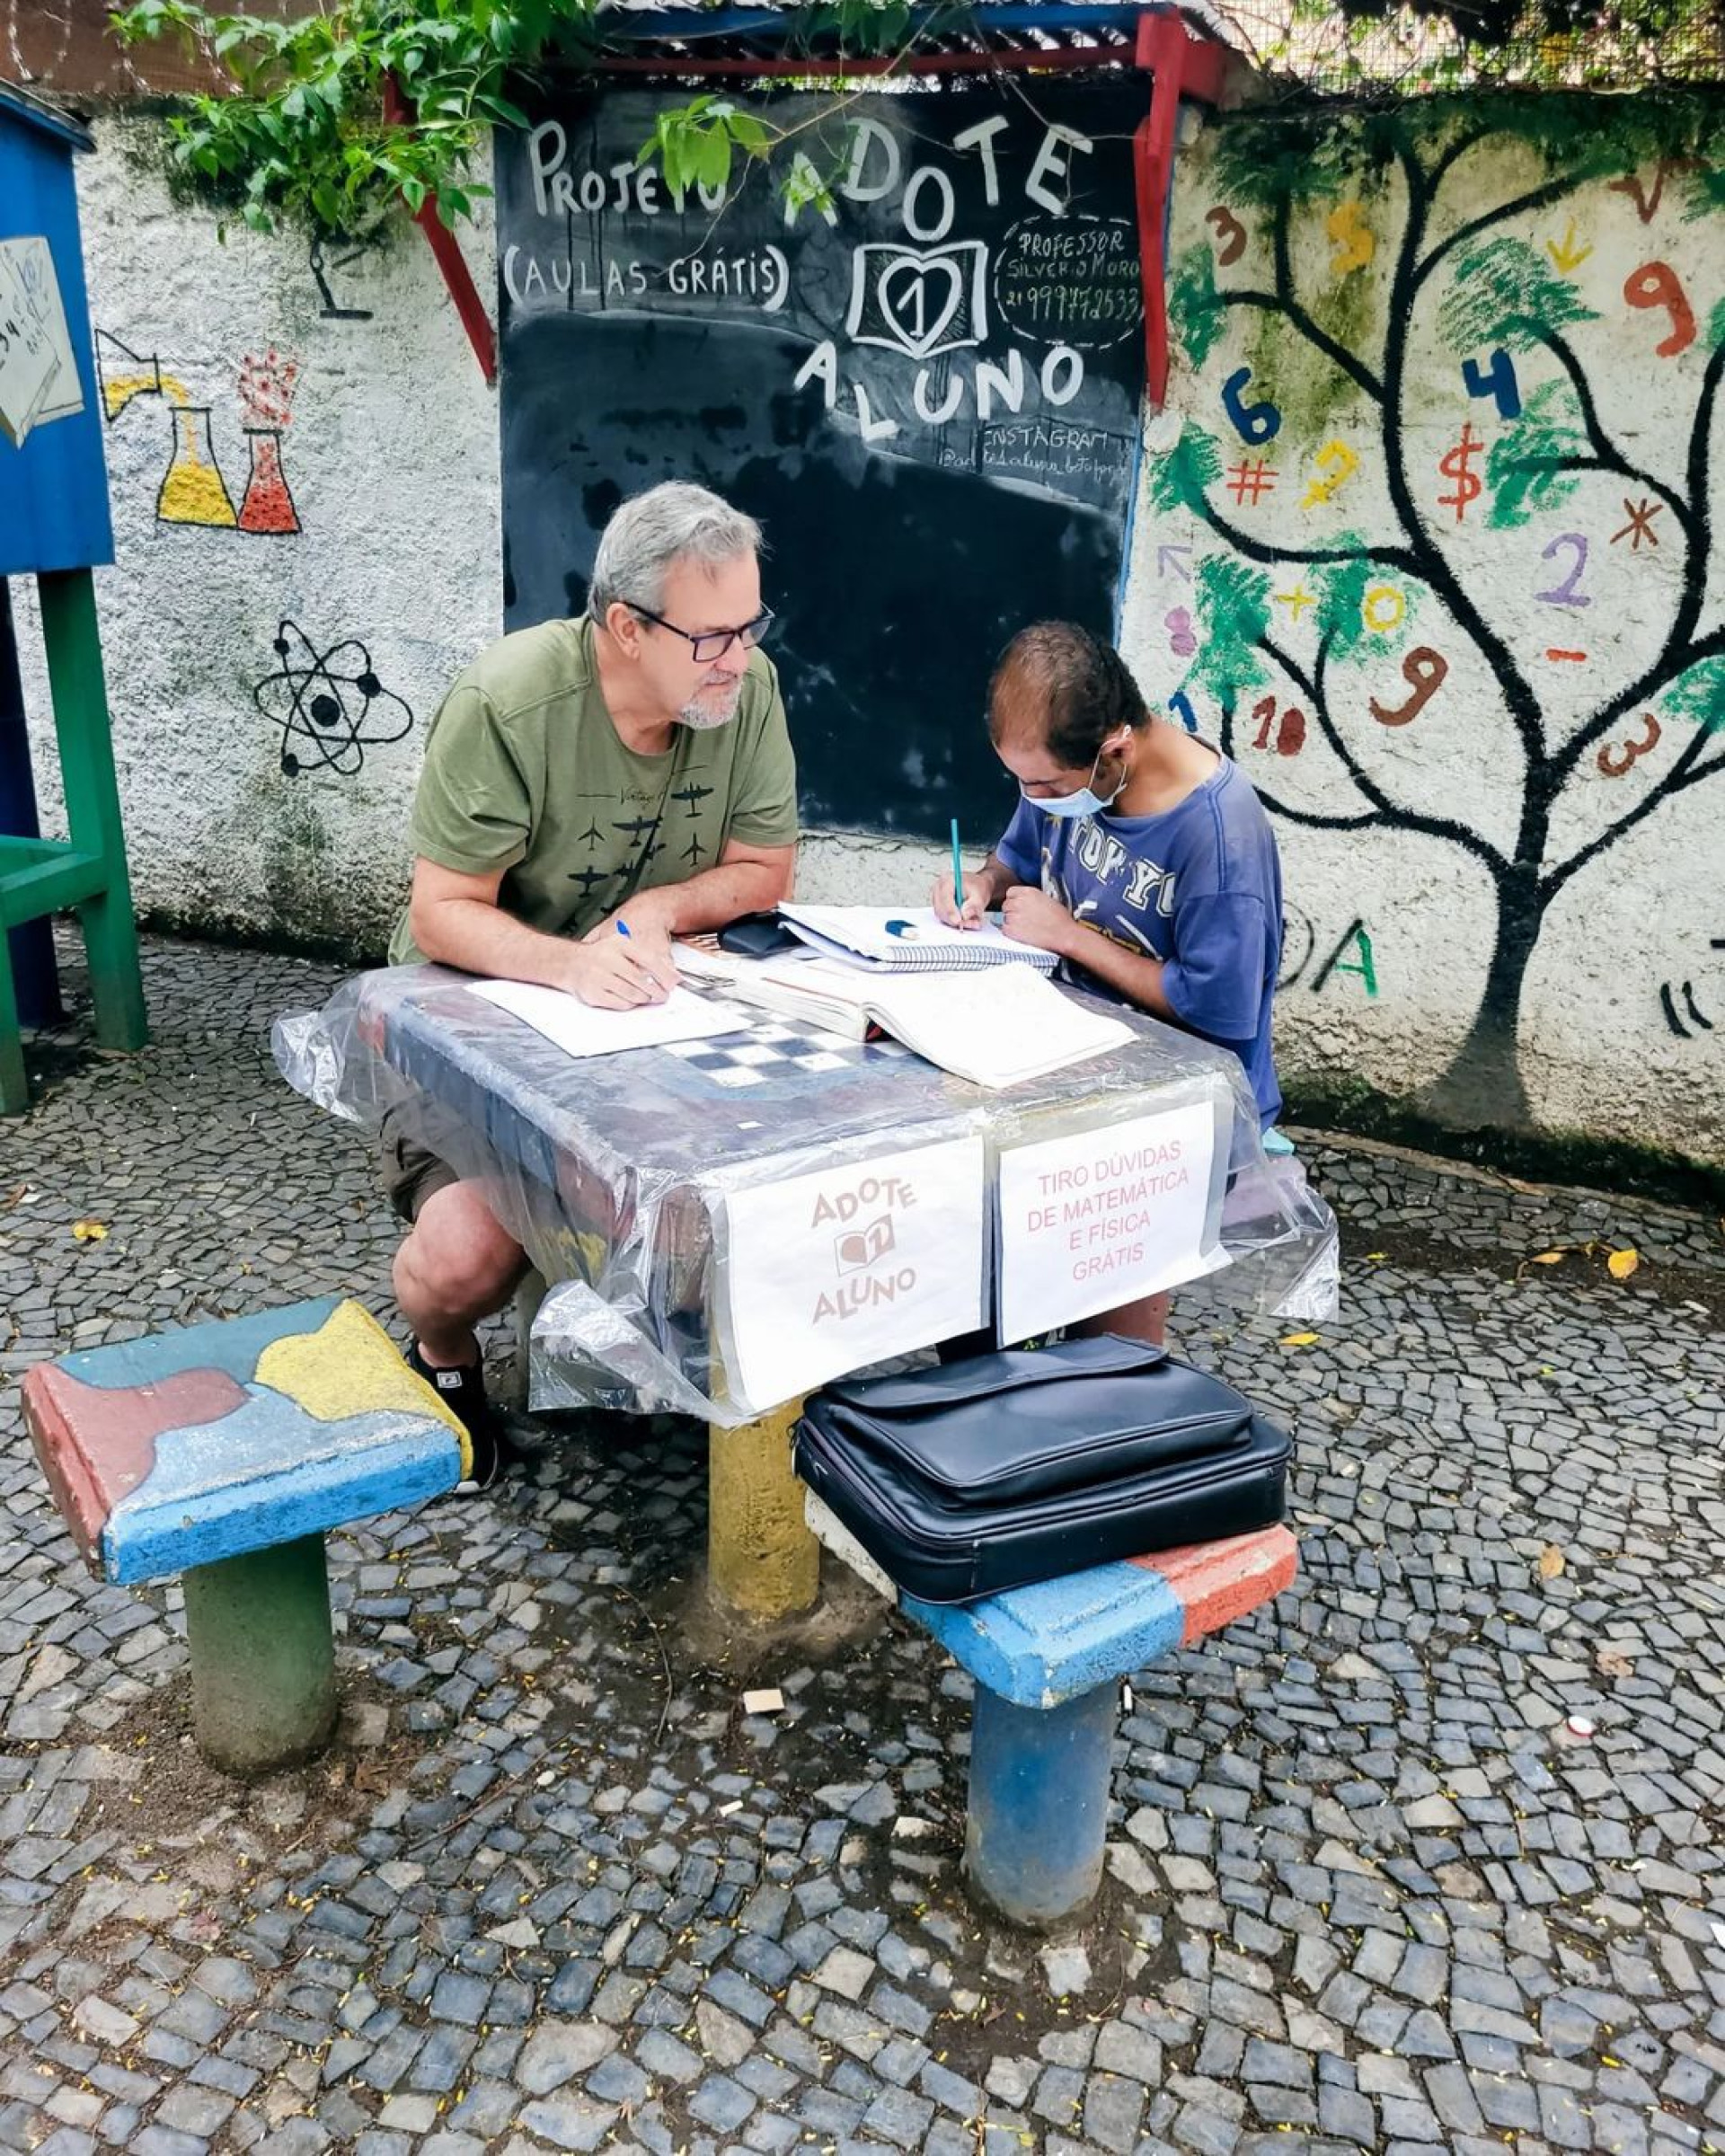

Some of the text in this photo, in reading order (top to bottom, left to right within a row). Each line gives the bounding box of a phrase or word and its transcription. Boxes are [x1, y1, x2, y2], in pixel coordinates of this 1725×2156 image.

[783, 116, 1093, 242] ADOTE
[1006, 257, 1087, 278] SILVERO
[1018, 230, 1126, 259] PROFESSOR
[898, 278, 925, 339] 1
[794, 340, 1084, 442] ALUNO
[1221, 367, 1282, 446] 6
[1462, 349, 1522, 420] 4
[1535, 533, 1592, 608] 2
[1039, 1140, 1182, 1196] TIRO DÚVIDAS
[811, 1178, 917, 1228] ADOTE
[1028, 1167, 1189, 1232] DE MATEMÁTICA
[1069, 1210, 1150, 1250] E FÍSICA
[1073, 1242, 1145, 1281] GRÁTIS
[812, 1268, 916, 1325] ALUNO
